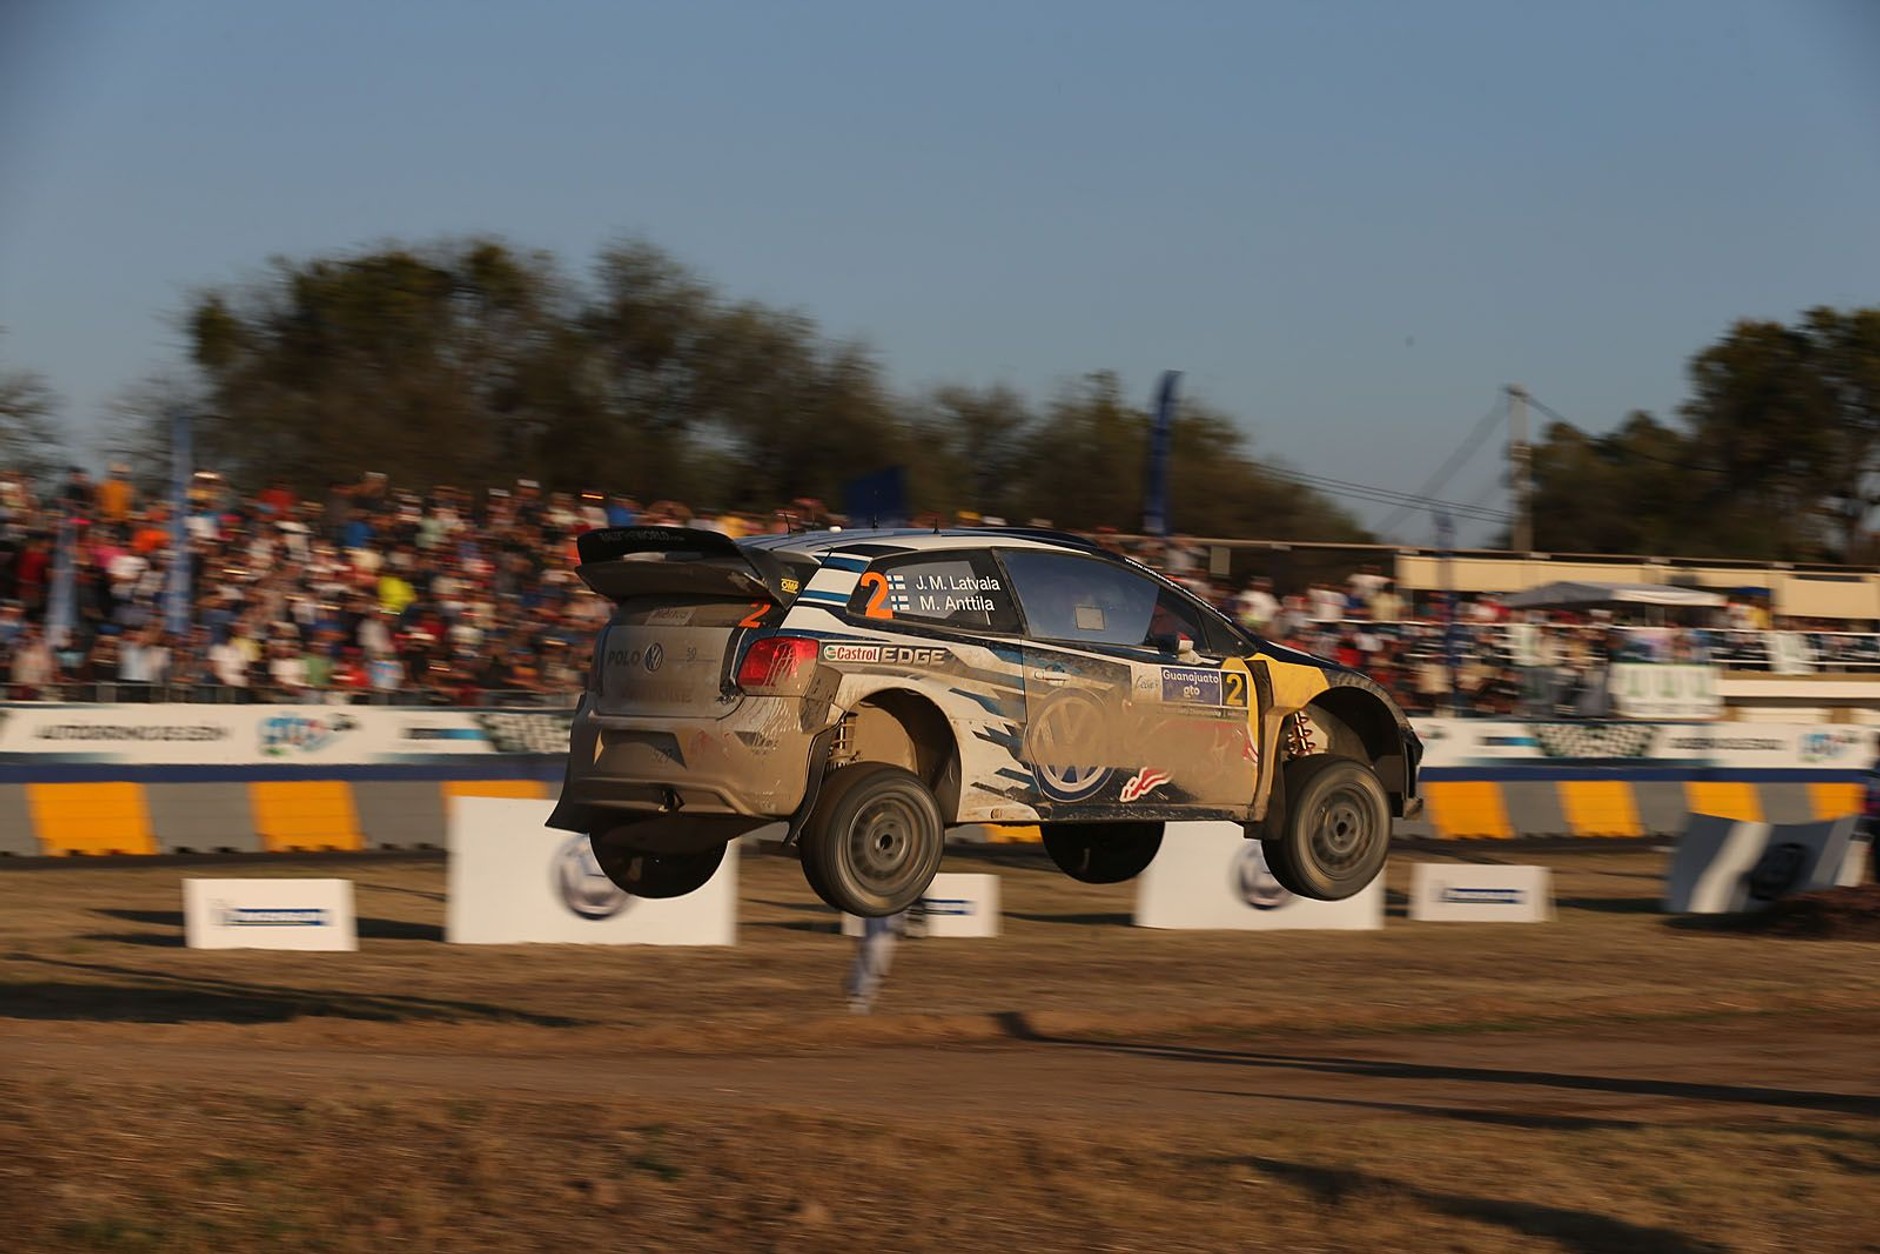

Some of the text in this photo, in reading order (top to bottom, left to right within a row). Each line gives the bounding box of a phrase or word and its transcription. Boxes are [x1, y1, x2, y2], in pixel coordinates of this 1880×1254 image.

[949, 575, 1001, 591] Latvala
[860, 571, 894, 620] 2
[919, 595, 996, 611] M. Anttila
[738, 603, 771, 629] 2
[607, 650, 641, 667] POLO
[836, 646, 947, 665] Castrol EDGE
[1162, 669, 1220, 685] Guanajuato
[1183, 685, 1201, 698] gto
[1225, 673, 1244, 706] 2
